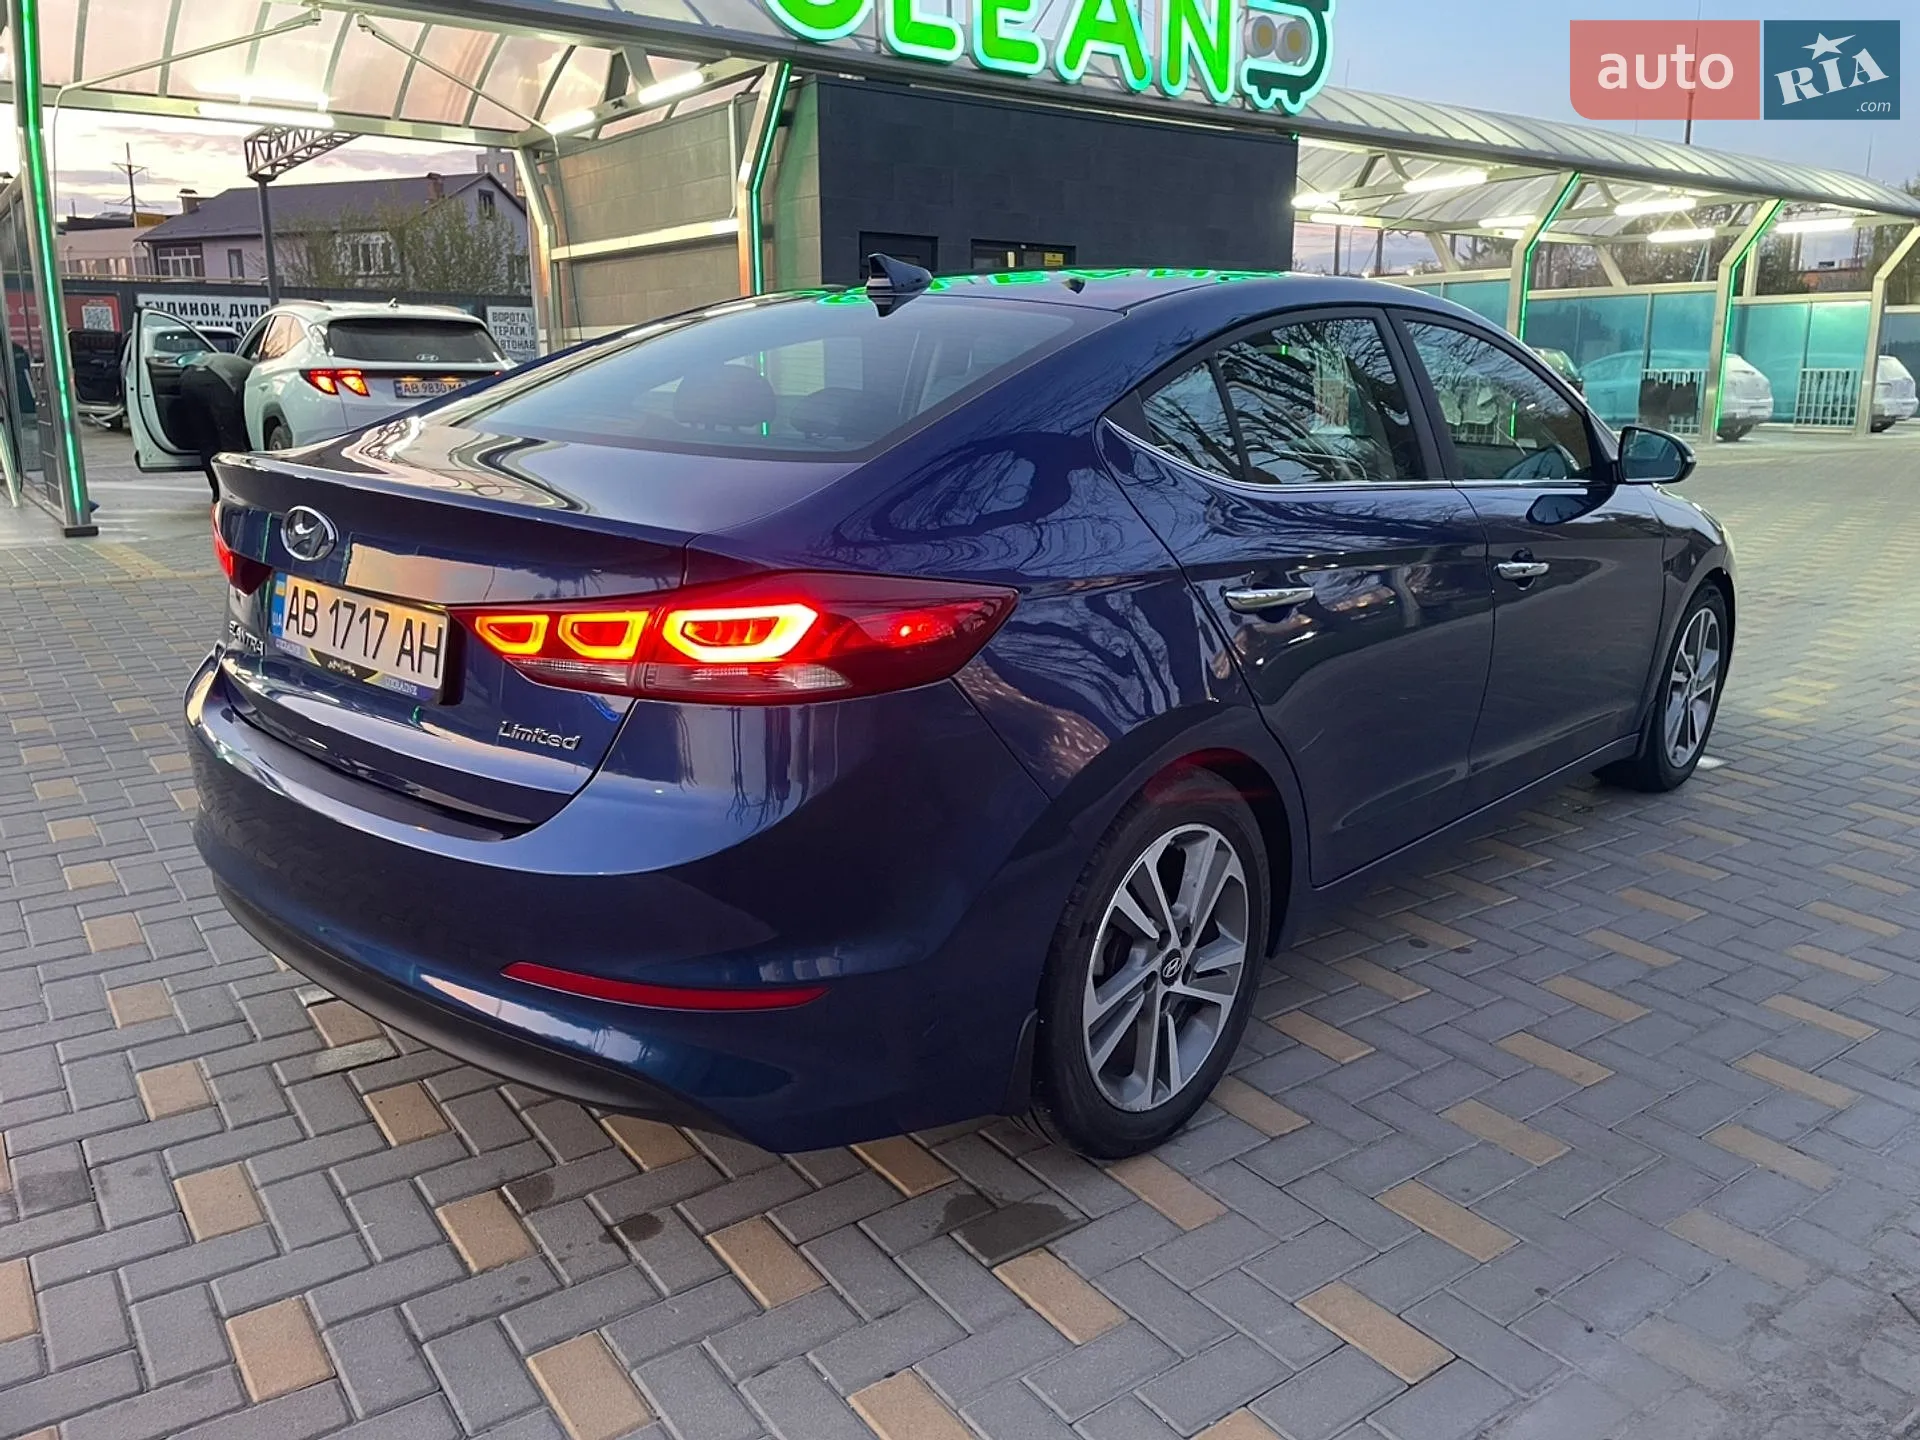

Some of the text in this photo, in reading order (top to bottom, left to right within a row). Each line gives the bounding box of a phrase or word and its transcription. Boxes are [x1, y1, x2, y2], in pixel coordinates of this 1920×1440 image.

[285, 586, 443, 679] AB 1717 AH
[498, 720, 582, 751] Limited
